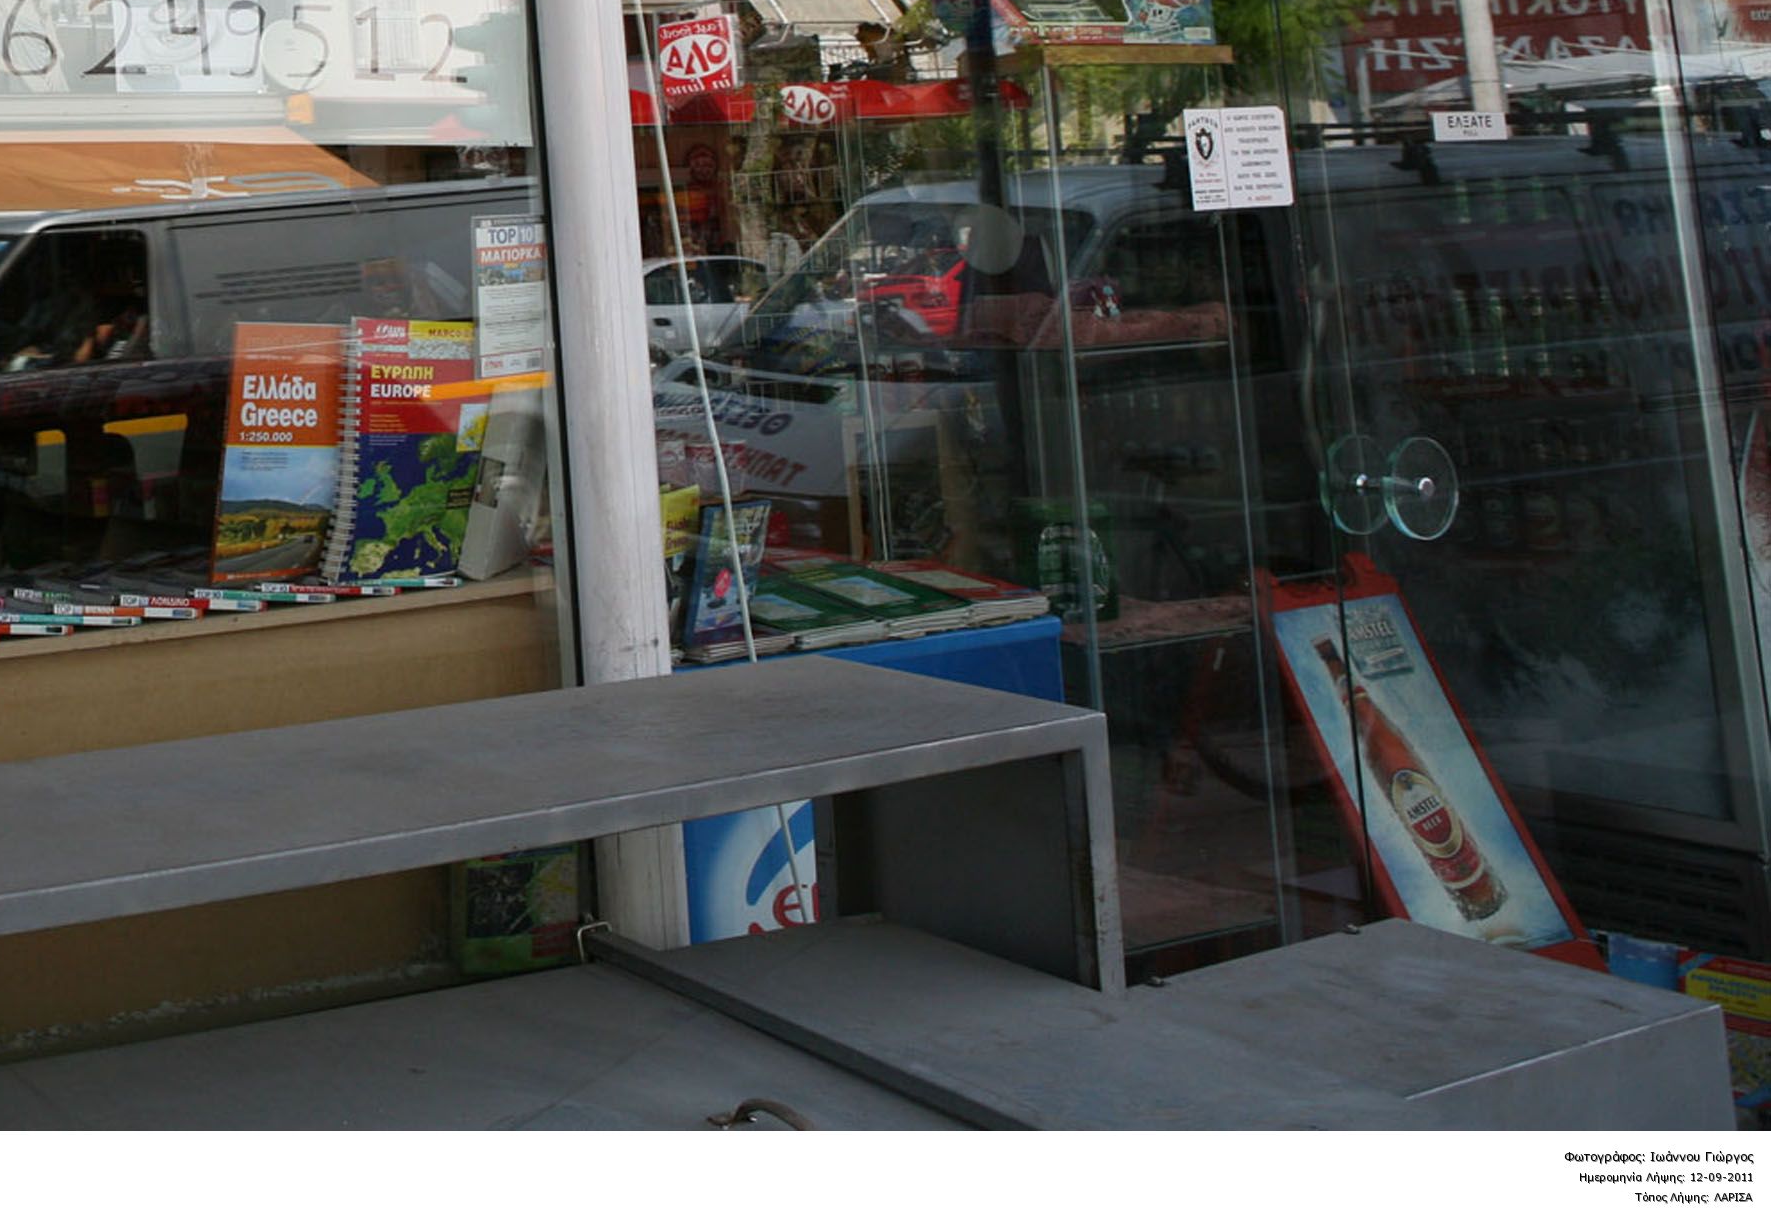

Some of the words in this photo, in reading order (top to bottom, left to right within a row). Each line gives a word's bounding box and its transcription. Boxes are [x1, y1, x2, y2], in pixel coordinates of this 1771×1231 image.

[488, 228, 516, 244] TOP
[521, 227, 533, 243] 10
[481, 246, 542, 263] ΜΑΓΙΟΡΚΑ
[371, 365, 434, 380] ΕΥΡΩΠΗ
[242, 374, 317, 400] Ελλάδα
[370, 384, 431, 398] EUROPE
[241, 402, 318, 427] Greece
